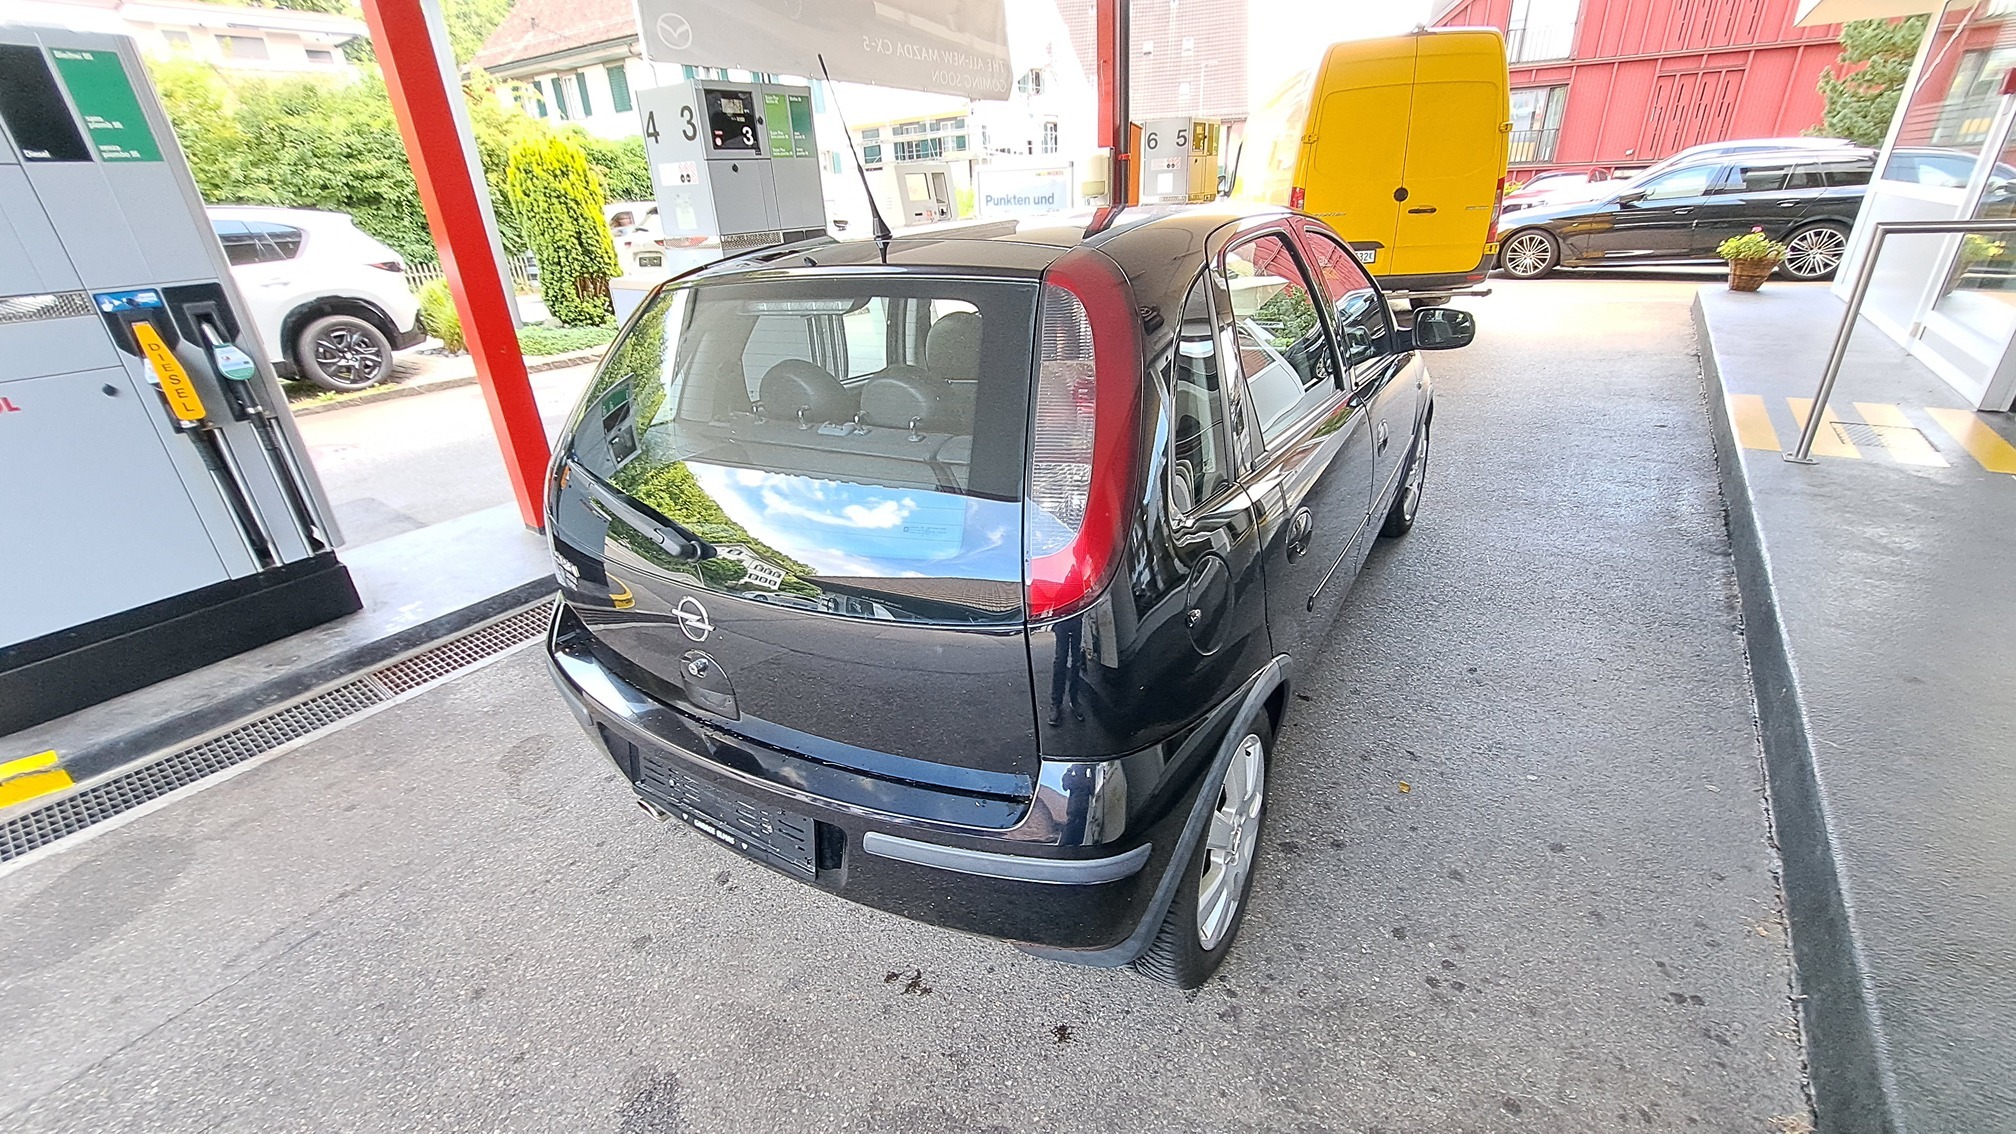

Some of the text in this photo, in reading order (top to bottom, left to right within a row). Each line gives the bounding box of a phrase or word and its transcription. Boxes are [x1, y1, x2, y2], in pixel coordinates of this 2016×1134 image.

[646, 105, 697, 144] 4 3
[742, 126, 754, 146] 3
[1147, 129, 1187, 149] 6 5
[985, 193, 1055, 207] Punkten und
[147, 343, 195, 412] DIESEL
